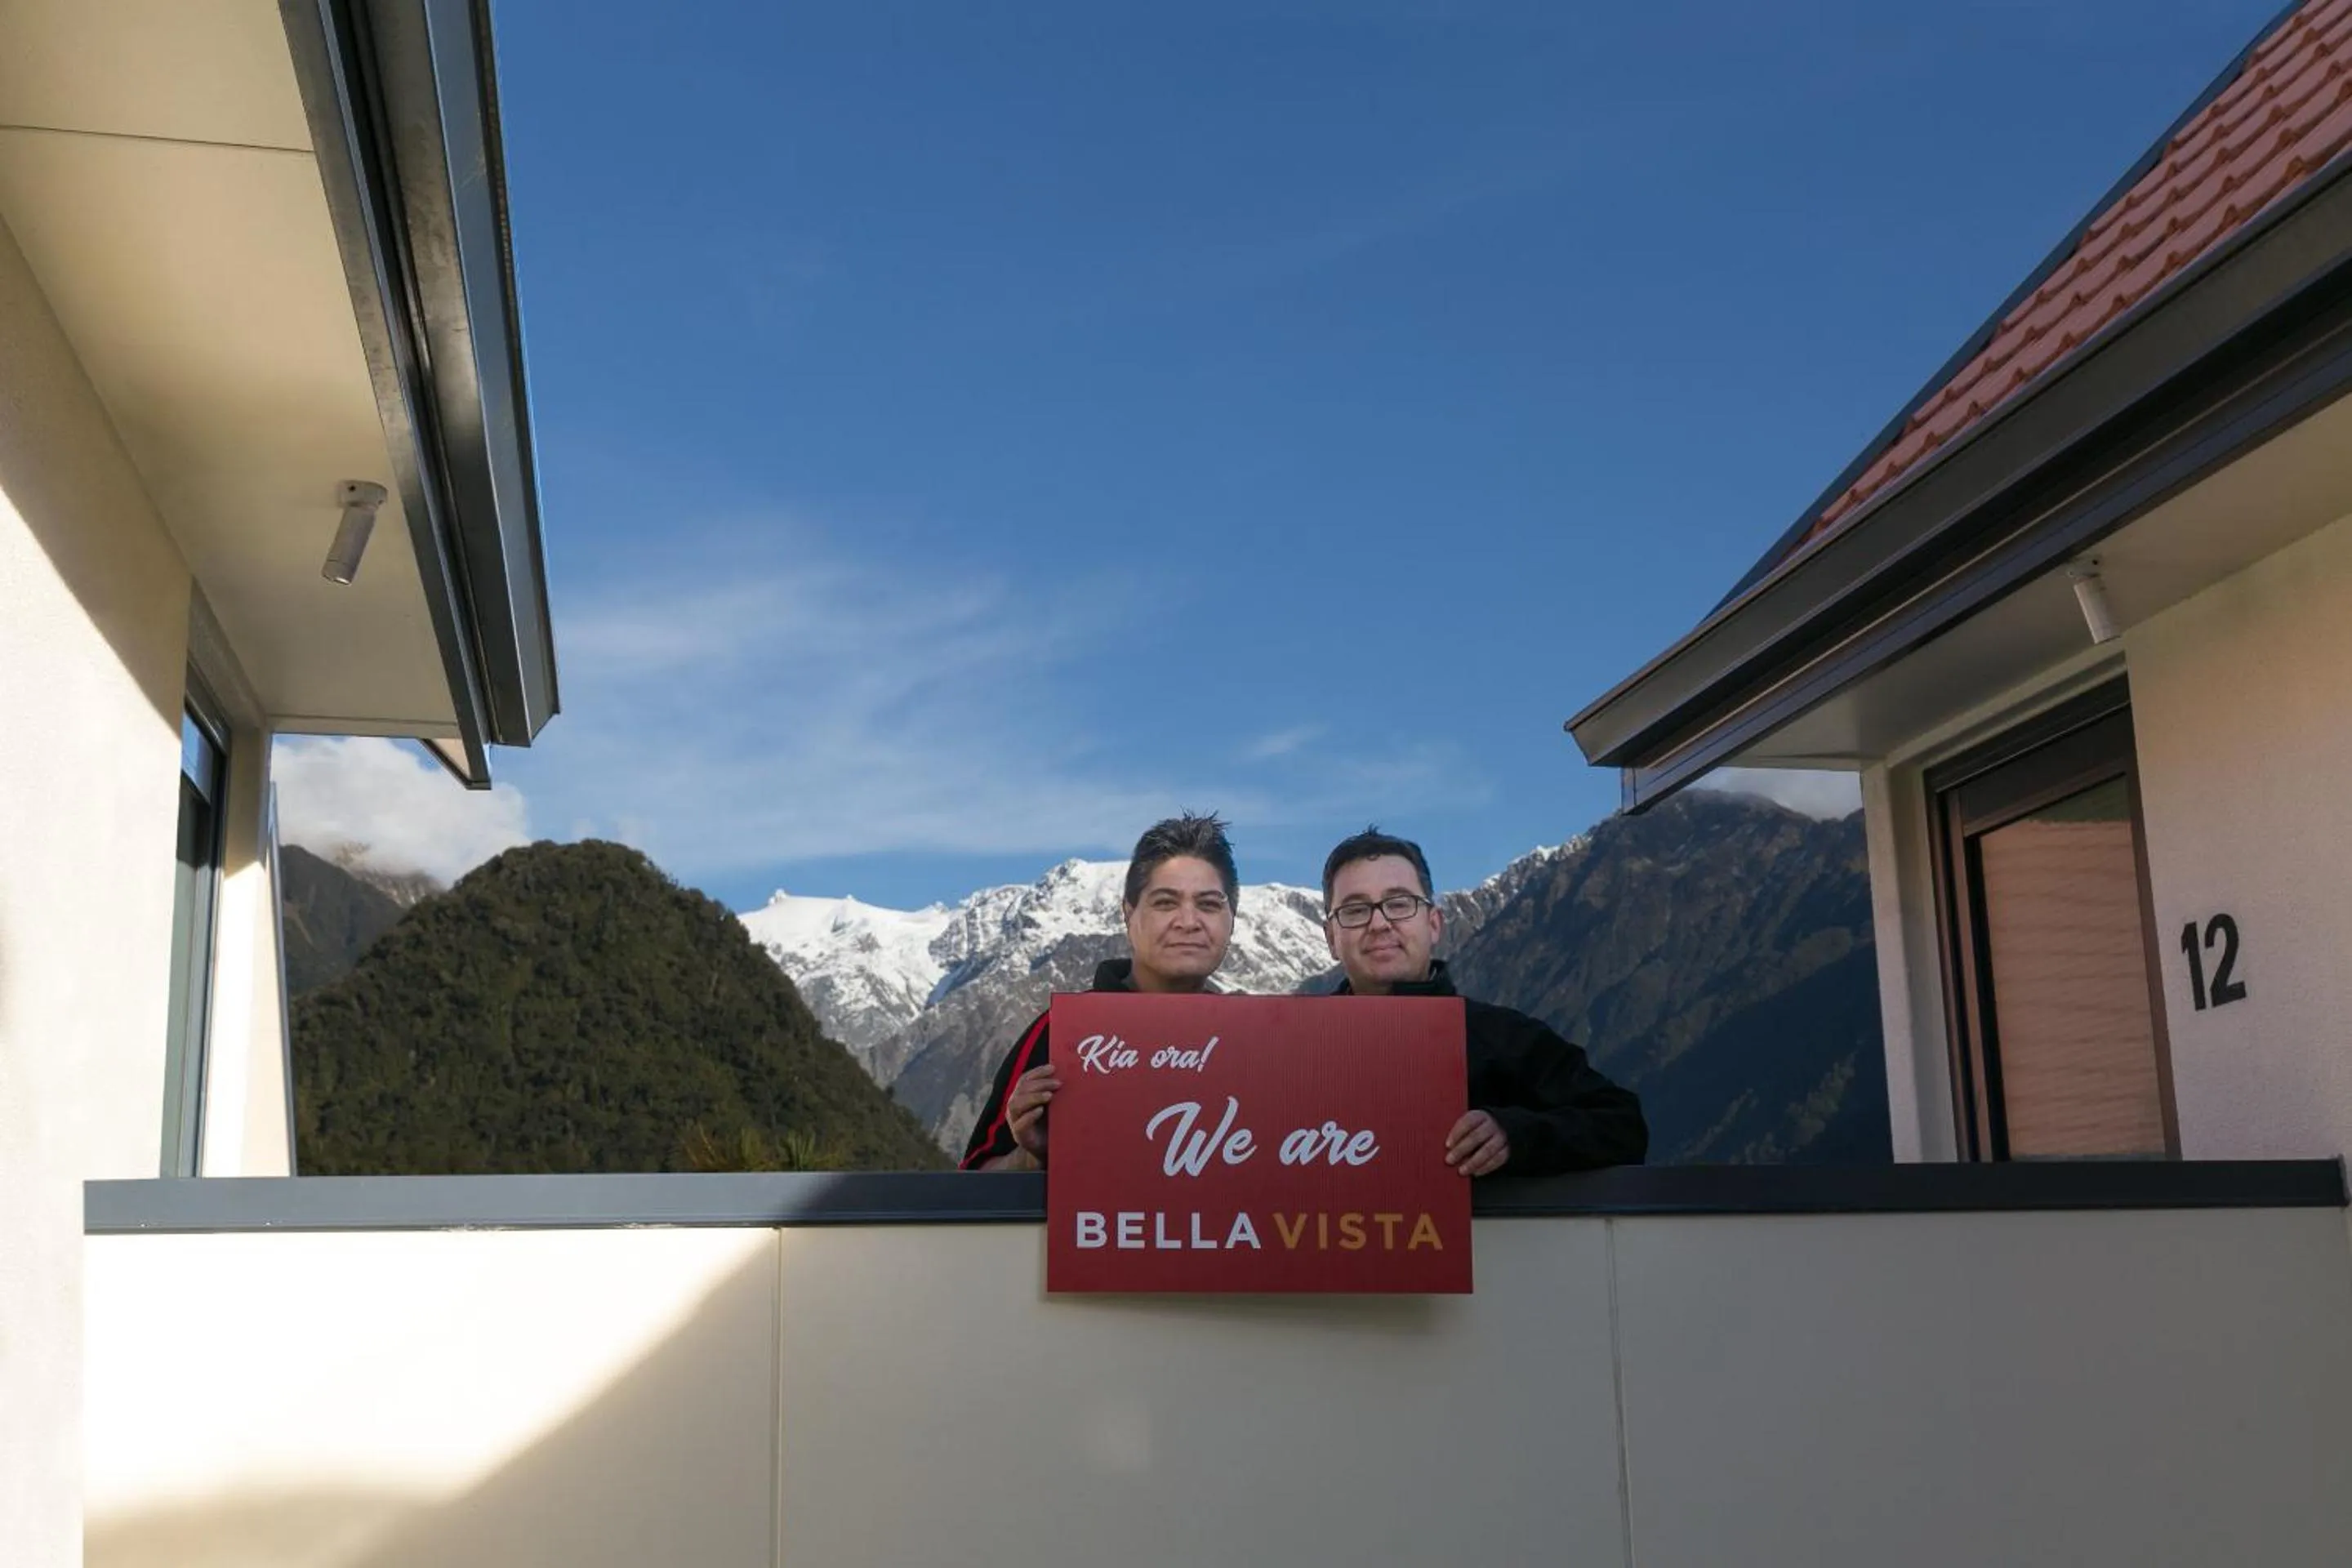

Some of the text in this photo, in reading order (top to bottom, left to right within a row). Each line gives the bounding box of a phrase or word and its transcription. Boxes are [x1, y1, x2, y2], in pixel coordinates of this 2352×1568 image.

[2180, 913, 2247, 1011] 12
[1076, 1034, 1219, 1075] Kia ora!
[1145, 1095, 1380, 1178] We are
[1076, 1211, 1444, 1250] BELLA VISTA
